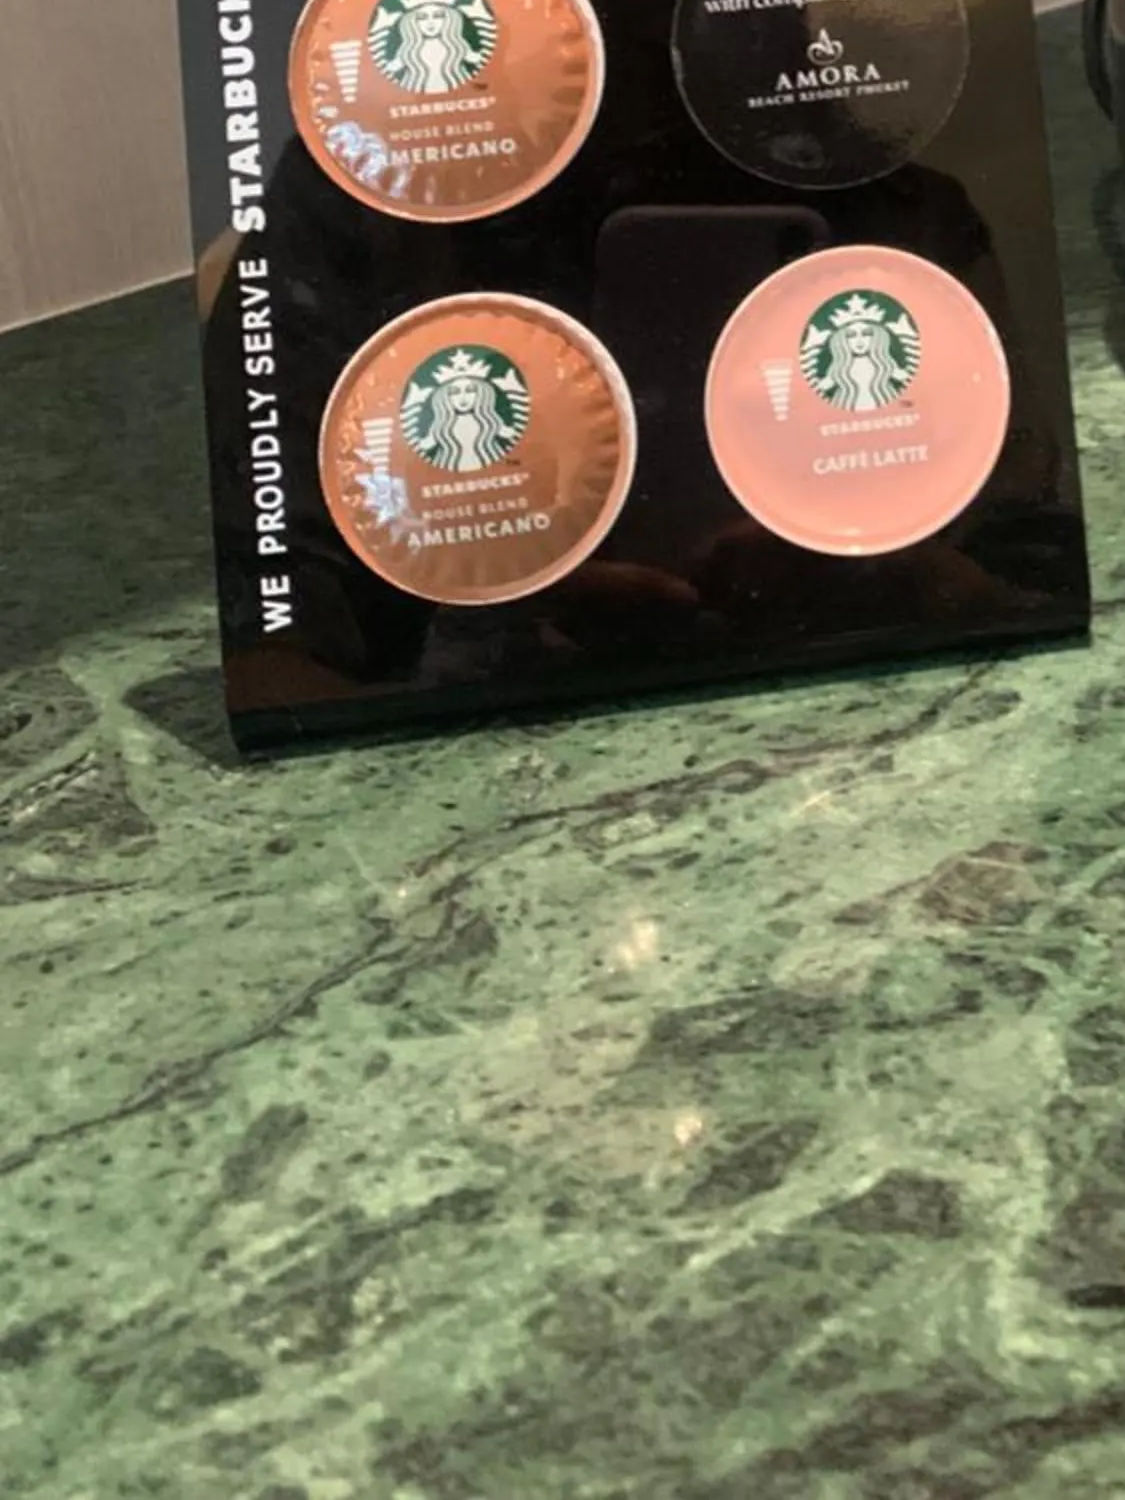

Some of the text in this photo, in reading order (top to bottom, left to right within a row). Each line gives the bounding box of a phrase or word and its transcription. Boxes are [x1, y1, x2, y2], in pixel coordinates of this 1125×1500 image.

[775, 63, 881, 92] AMORA
[238, 257, 275, 376] SERVE
[247, 388, 288, 556] PROUDLY
[872, 444, 929, 467] LATTE
[407, 512, 551, 549] AMERICANO
[260, 574, 294, 633] WE
